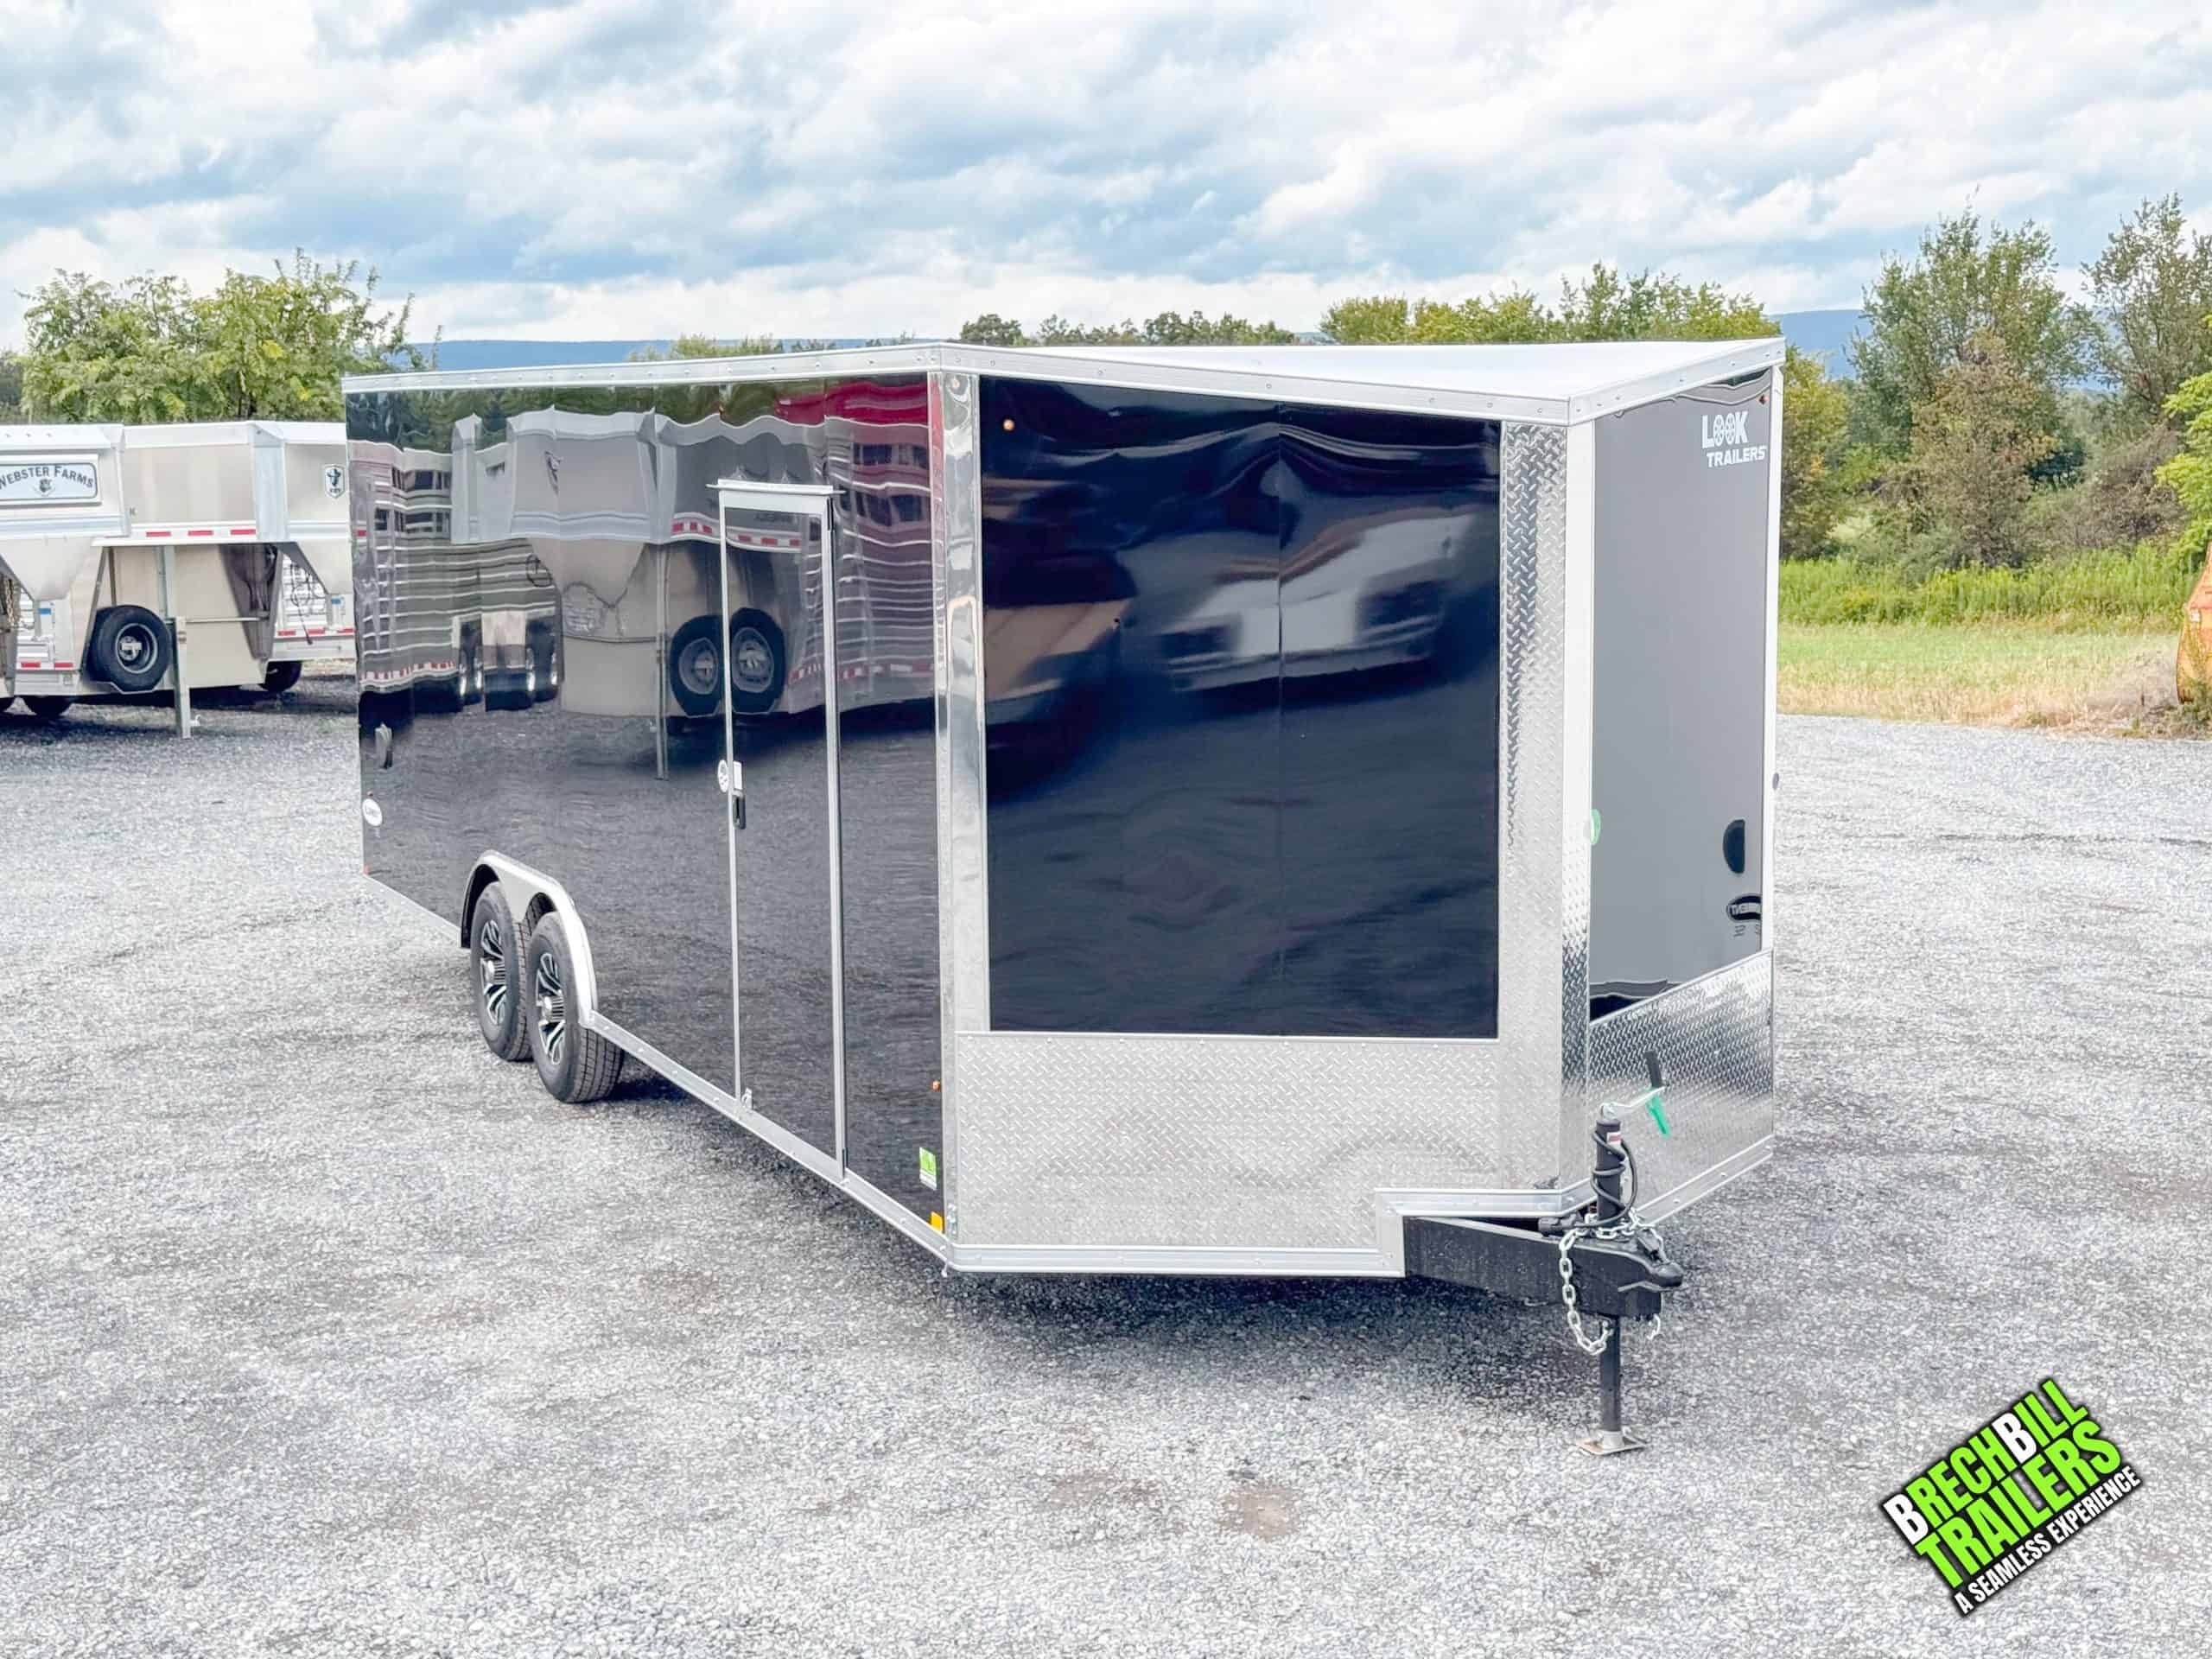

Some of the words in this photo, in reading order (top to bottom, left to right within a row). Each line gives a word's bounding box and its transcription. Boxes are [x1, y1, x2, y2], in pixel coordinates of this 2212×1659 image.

[1701, 411, 1748, 448] LOOK
[1707, 445, 1767, 467] TRAILERS
[54, 465, 93, 488] FARMS
